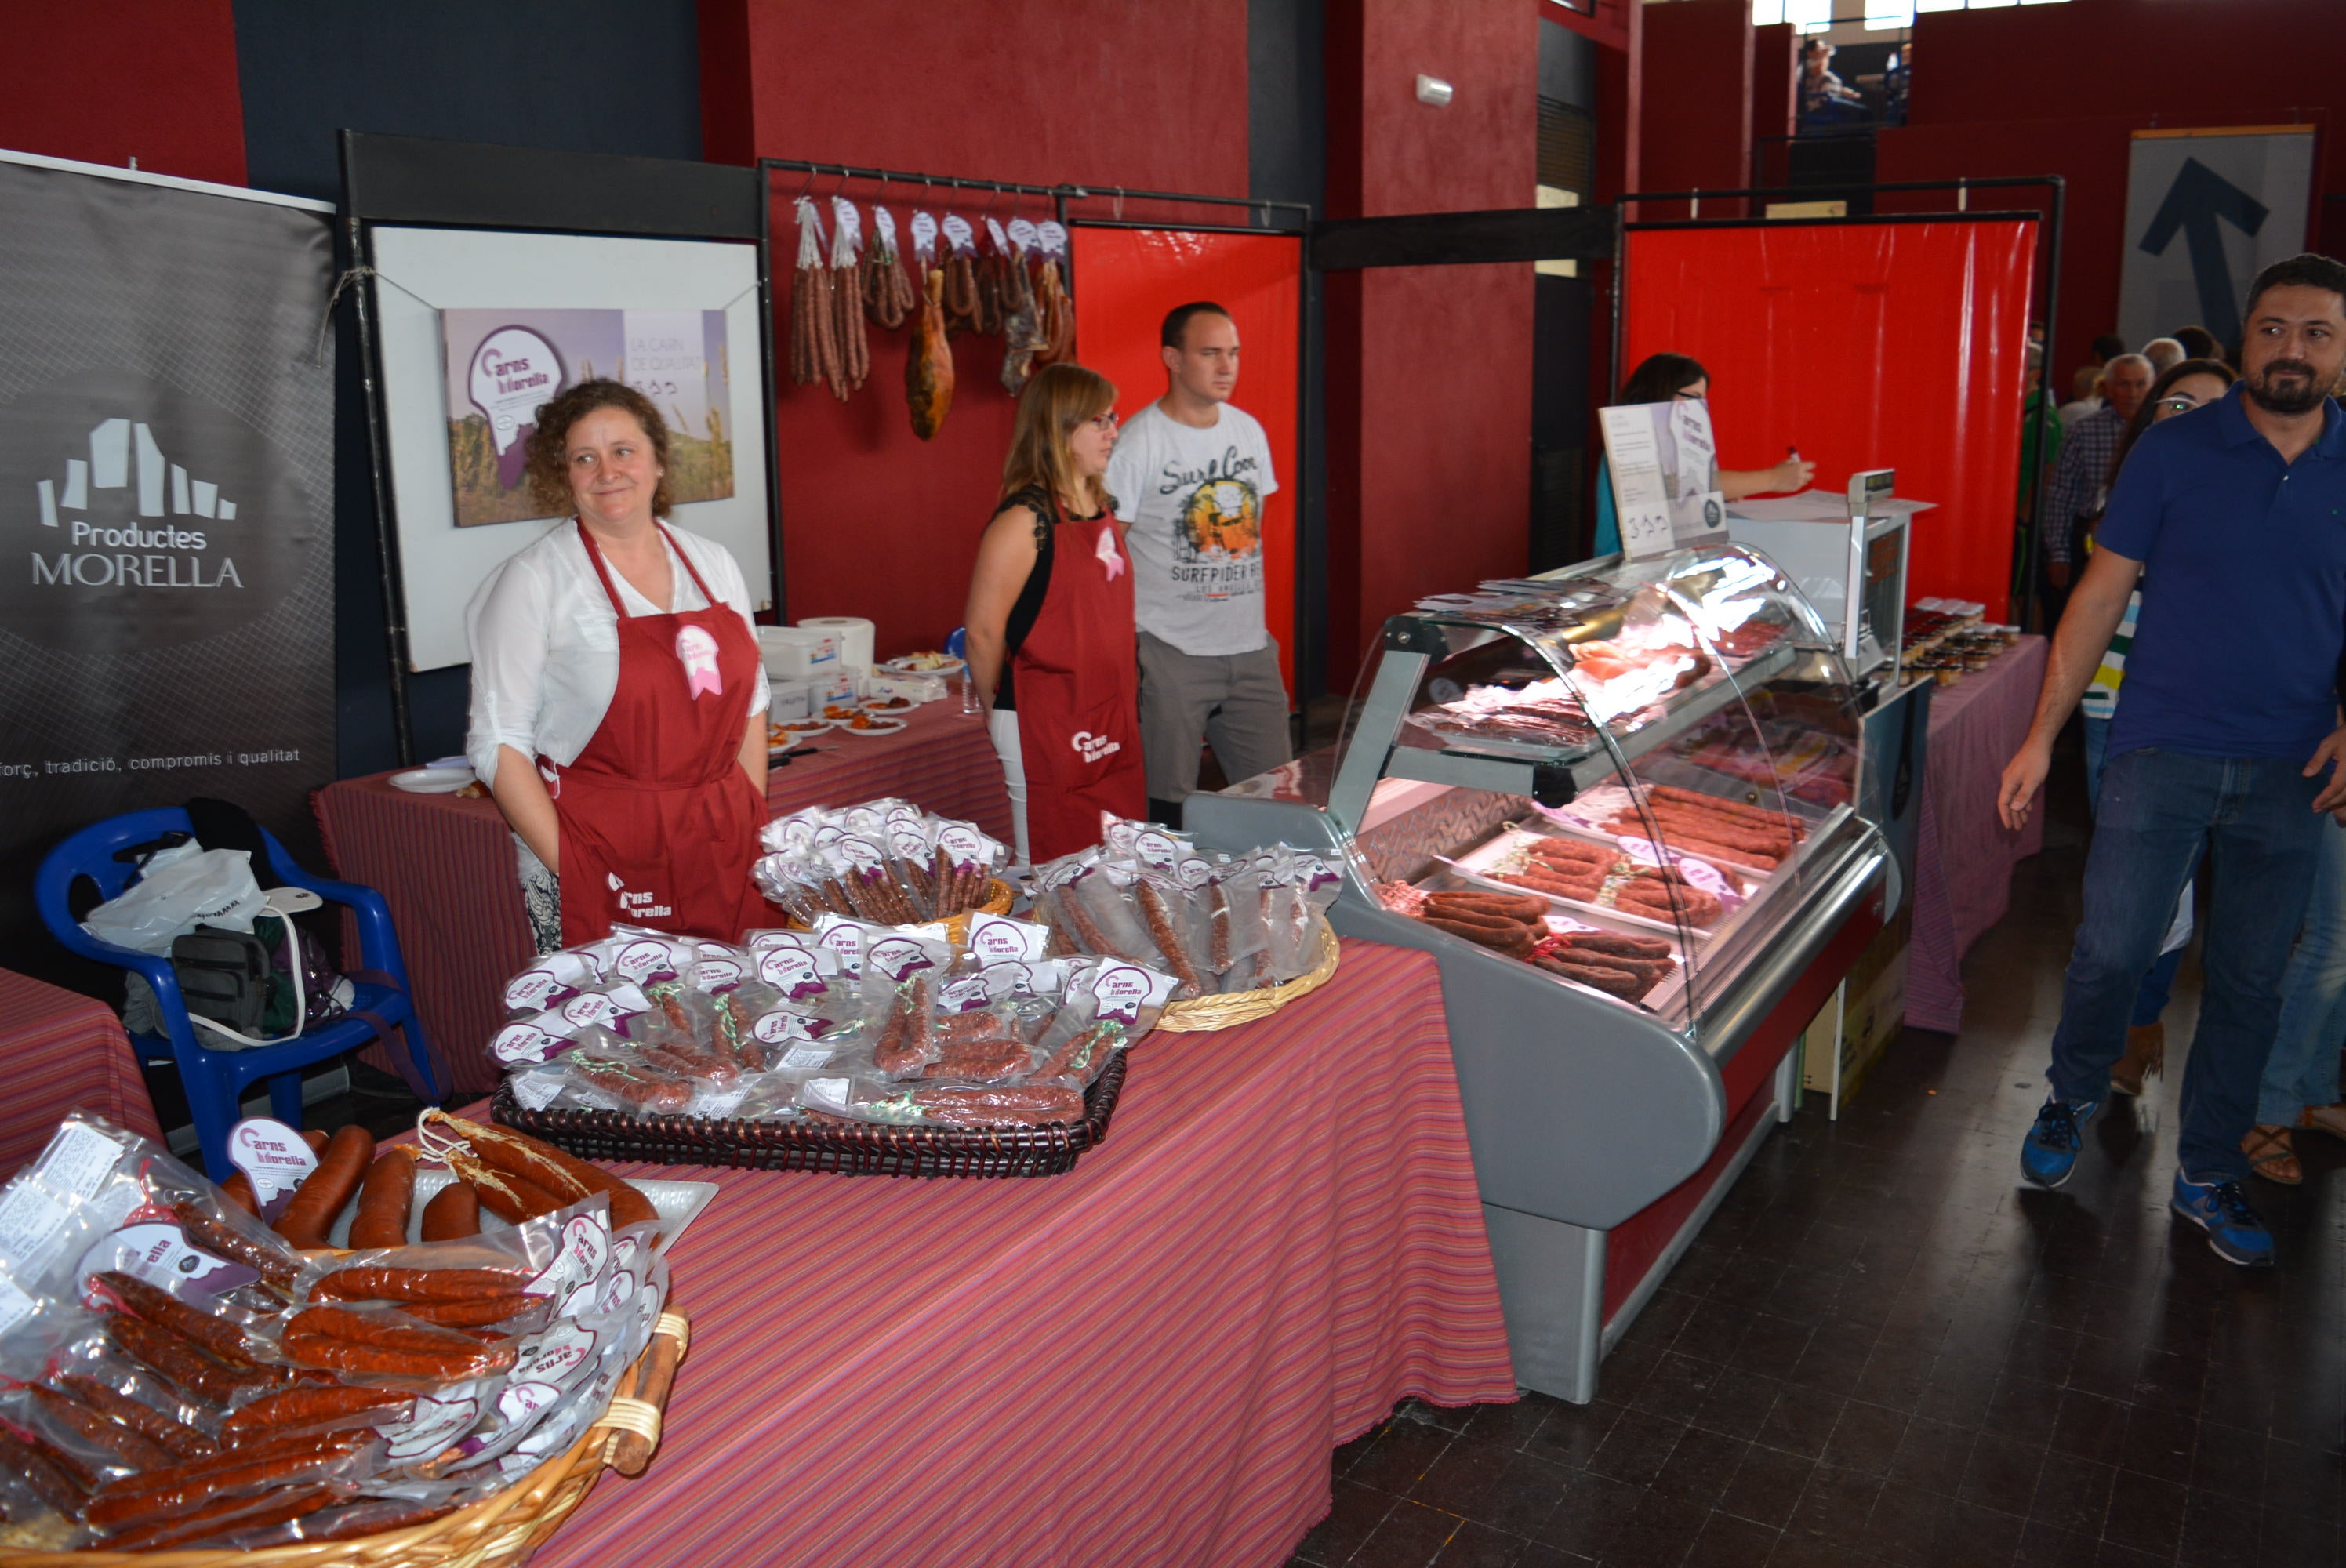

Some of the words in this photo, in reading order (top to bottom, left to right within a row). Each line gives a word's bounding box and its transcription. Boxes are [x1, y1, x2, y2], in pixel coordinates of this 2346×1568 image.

[481, 348, 531, 378] Carns
[497, 372, 549, 395] Morella
[71, 521, 208, 550] Productes
[31, 551, 245, 588] MORELLA
[45, 756, 122, 775] tradició,
[129, 752, 223, 771] compromís
[226, 750, 234, 764] i
[238, 747, 300, 767] qualitat
[627, 904, 672, 919] orella
[829, 932, 856, 947] Carns
[979, 931, 1008, 945] Carns
[621, 952, 651, 967] Carns
[766, 956, 795, 971] Carns
[777, 960, 808, 975] Morella
[507, 981, 535, 1000] Carns
[1105, 975, 1134, 988] Carns
[567, 1001, 592, 1018] Carns
[497, 1033, 523, 1054] Carns
[239, 1127, 288, 1152] Carns
[256, 1150, 307, 1166] Morella
[573, 1219, 598, 1261] Carns
[536, 1347, 586, 1374] Carns
